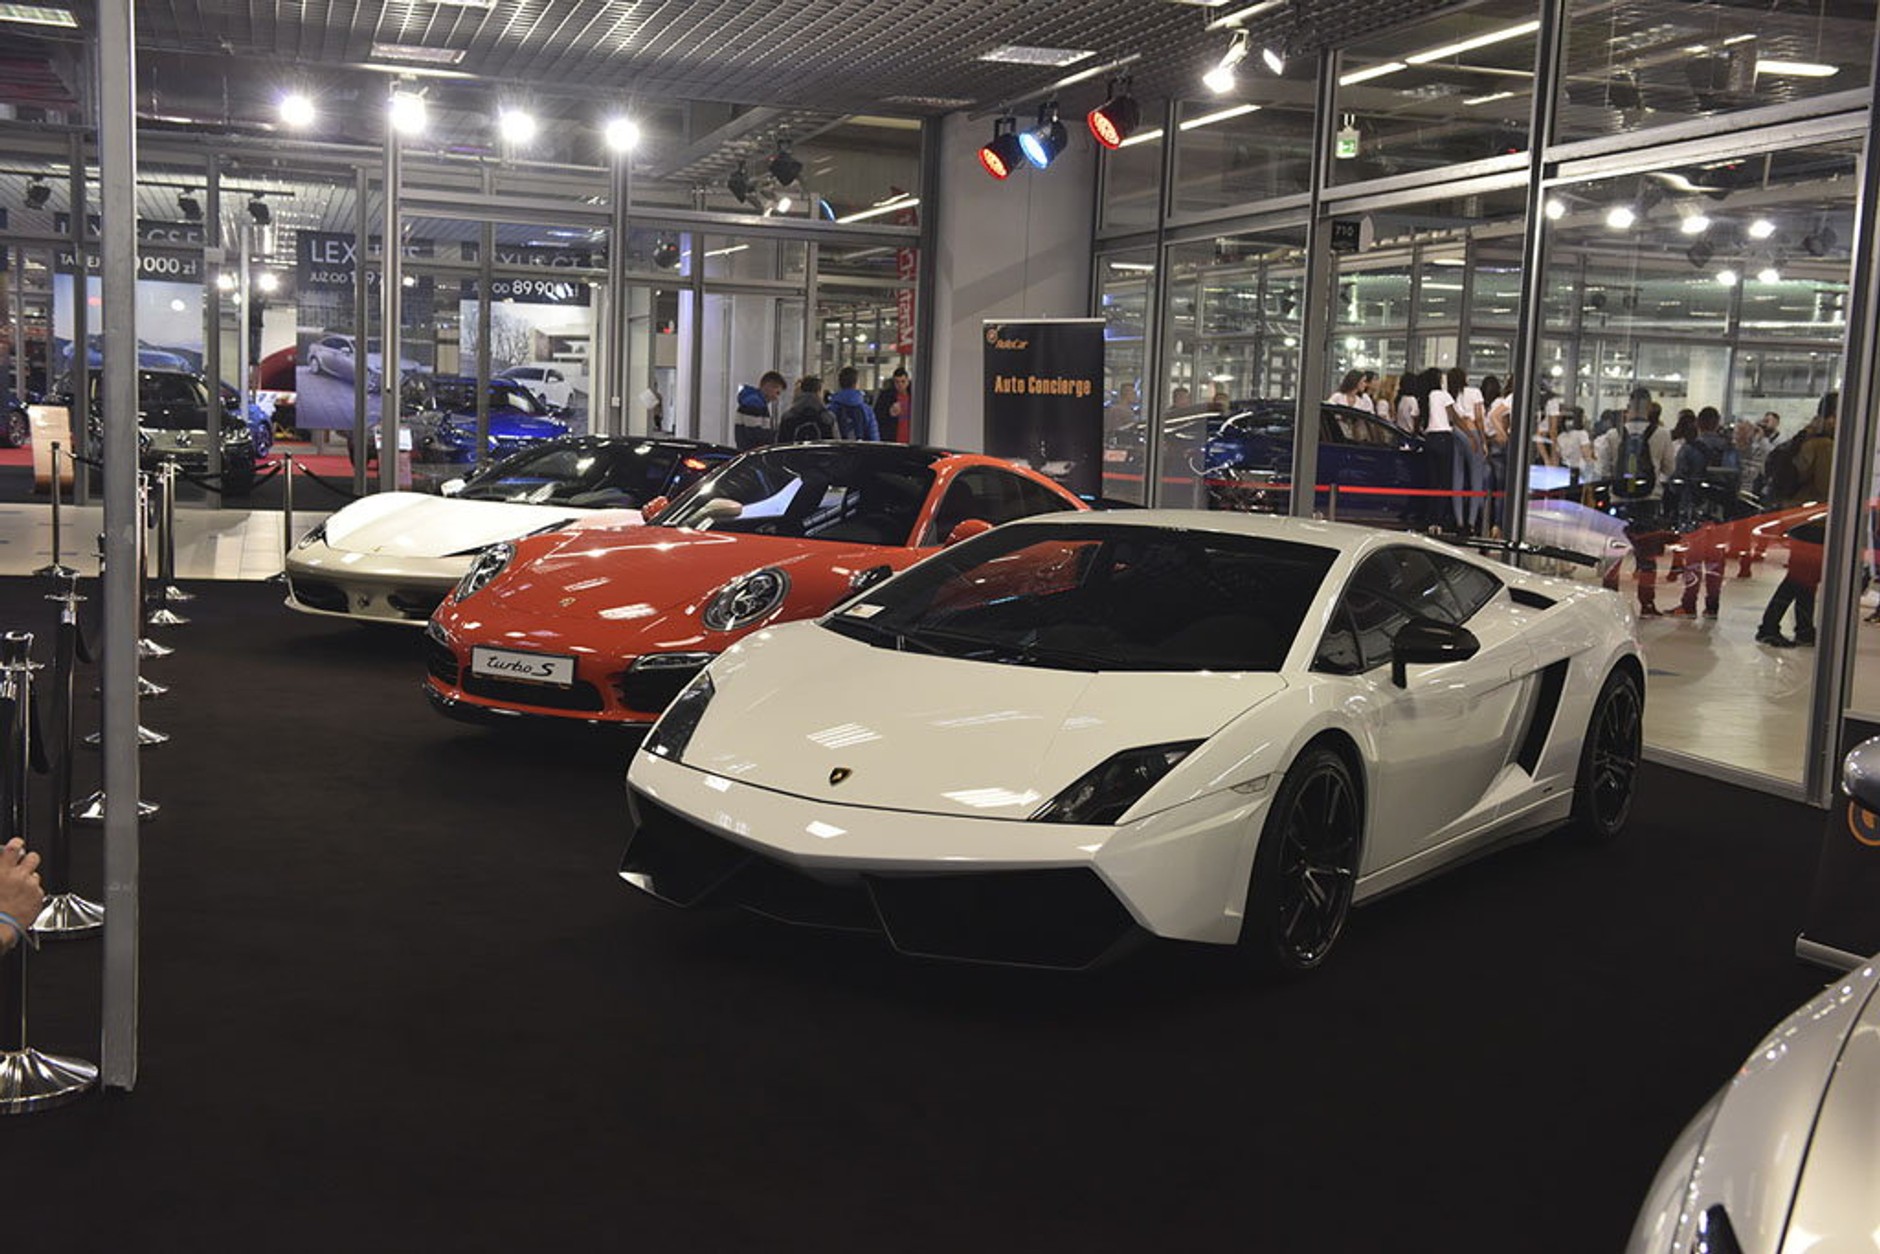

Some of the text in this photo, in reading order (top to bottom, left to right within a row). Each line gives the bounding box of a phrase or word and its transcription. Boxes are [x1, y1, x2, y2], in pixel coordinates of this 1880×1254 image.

[512, 280, 533, 295] 89
[994, 375, 1091, 398] Auto Concierge
[486, 656, 556, 677] turbo S
